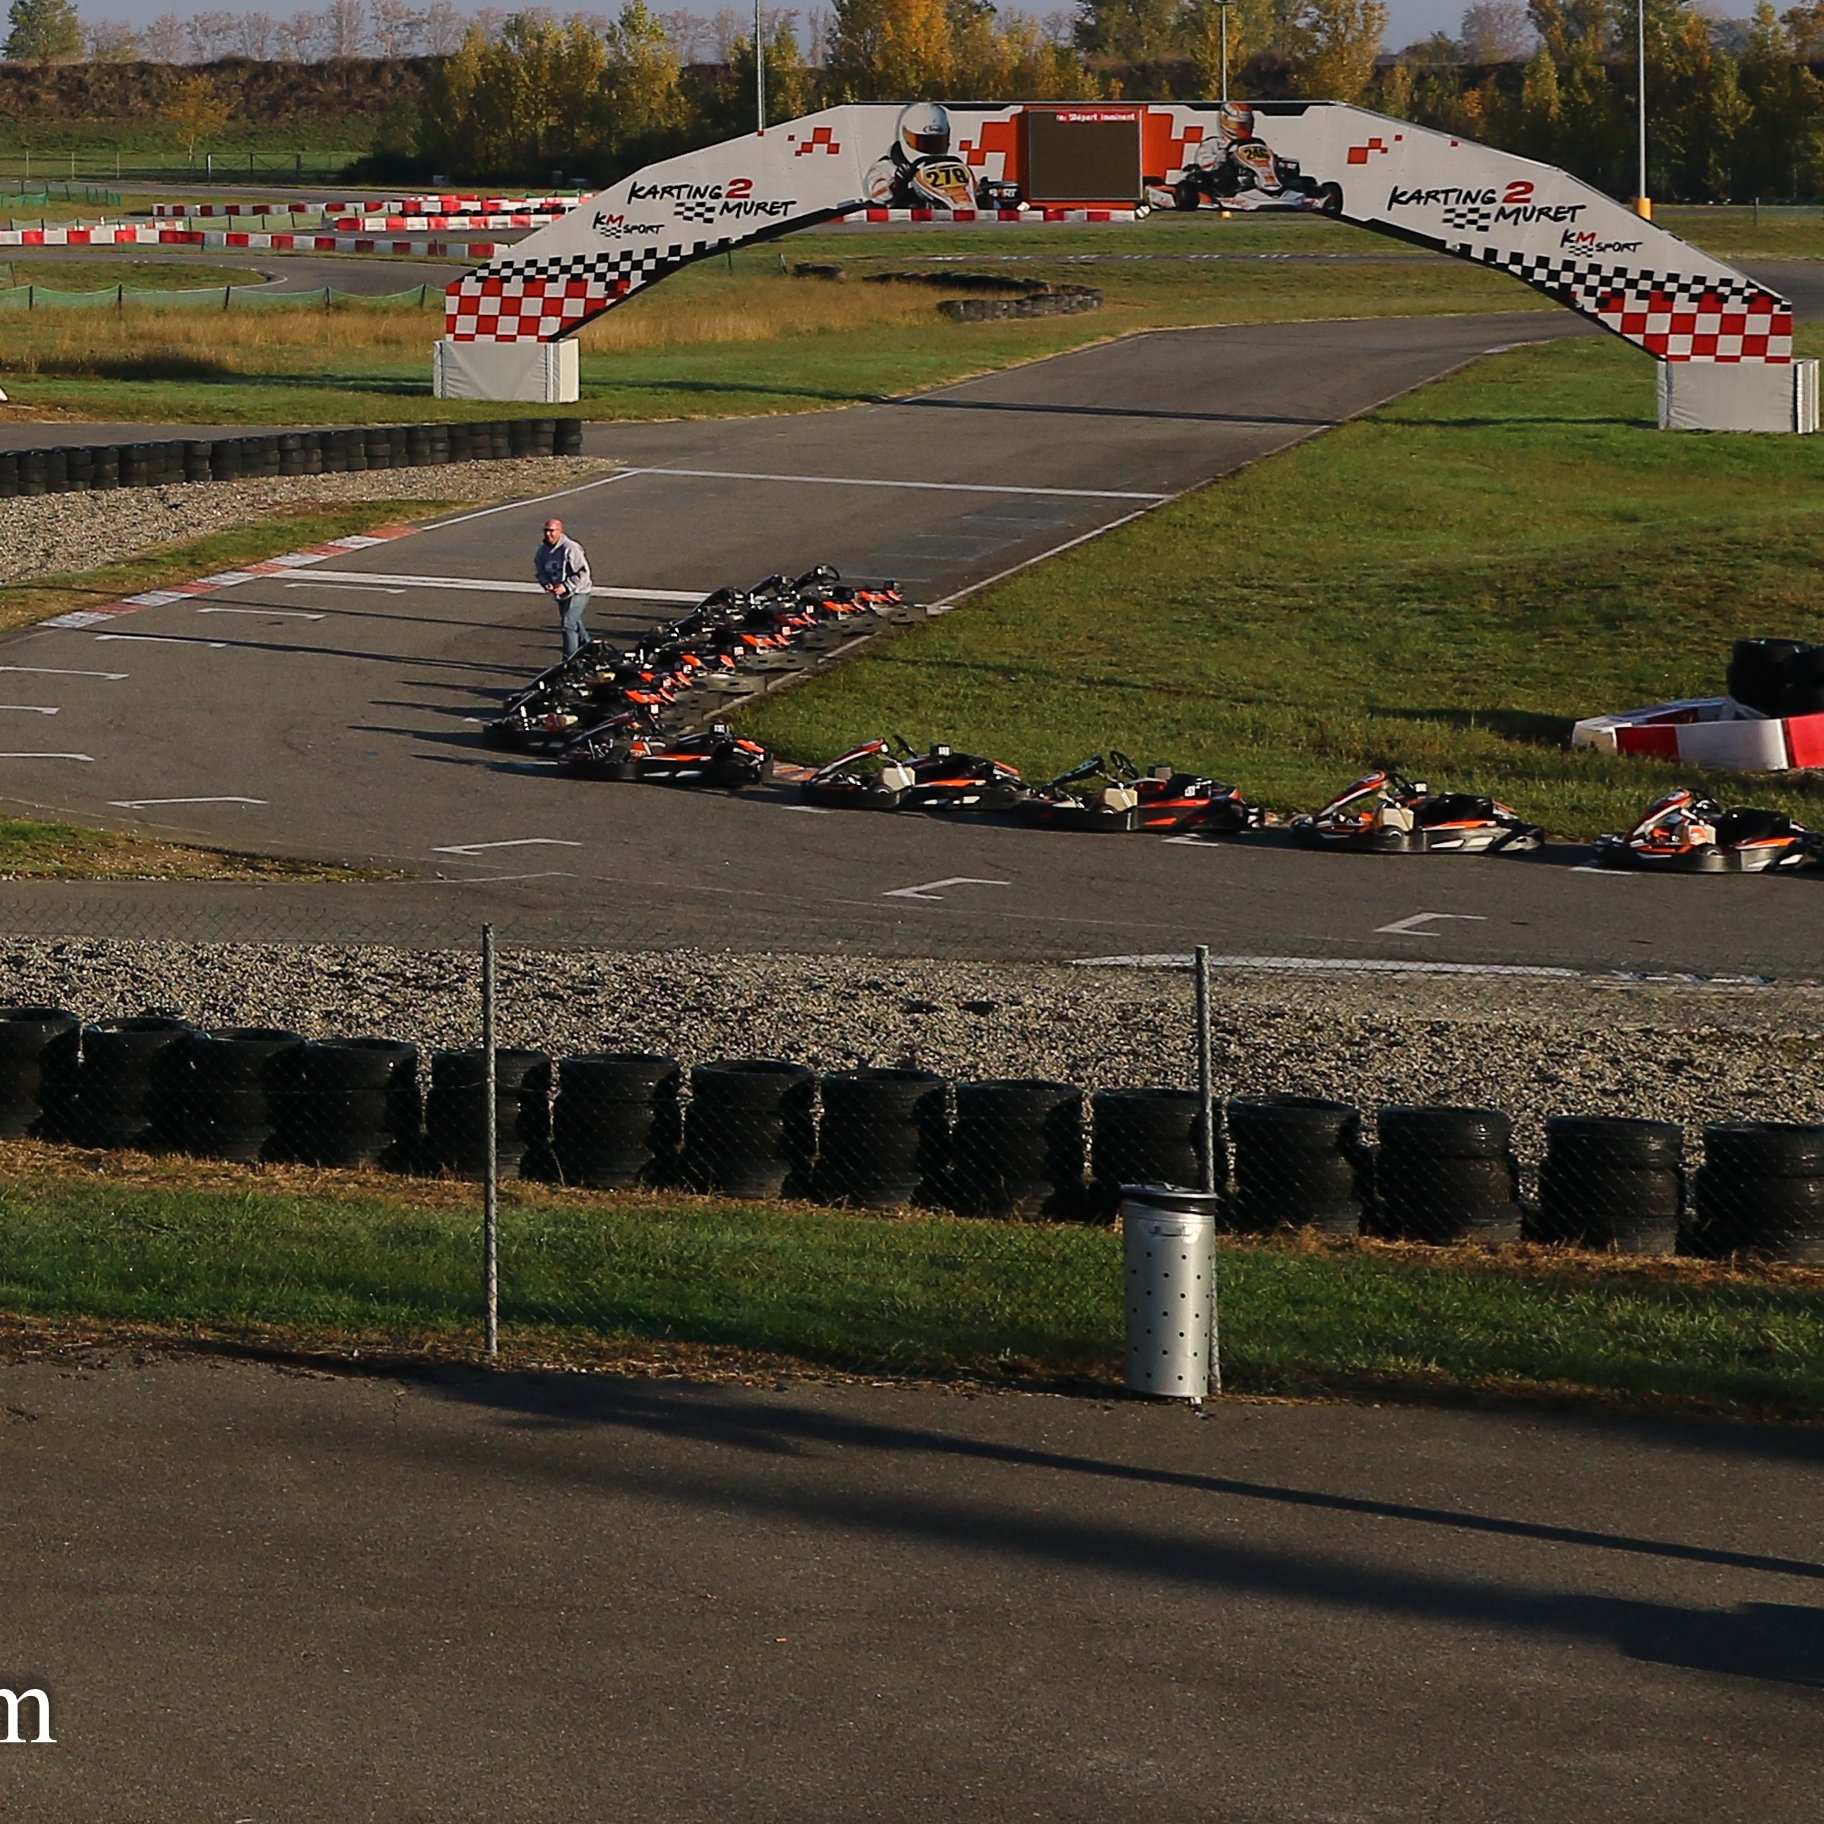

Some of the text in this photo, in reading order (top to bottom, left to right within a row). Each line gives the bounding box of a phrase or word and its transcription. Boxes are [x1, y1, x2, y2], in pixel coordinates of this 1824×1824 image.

[628, 178, 753, 204] KARTING 2
[1387, 181, 1534, 210] KARTING 2
[719, 200, 797, 216] MURET
[1494, 205, 1586, 226] MURET
[593, 211, 665, 235] KM SPORT
[1560, 229, 1643, 253] KM SPORT
